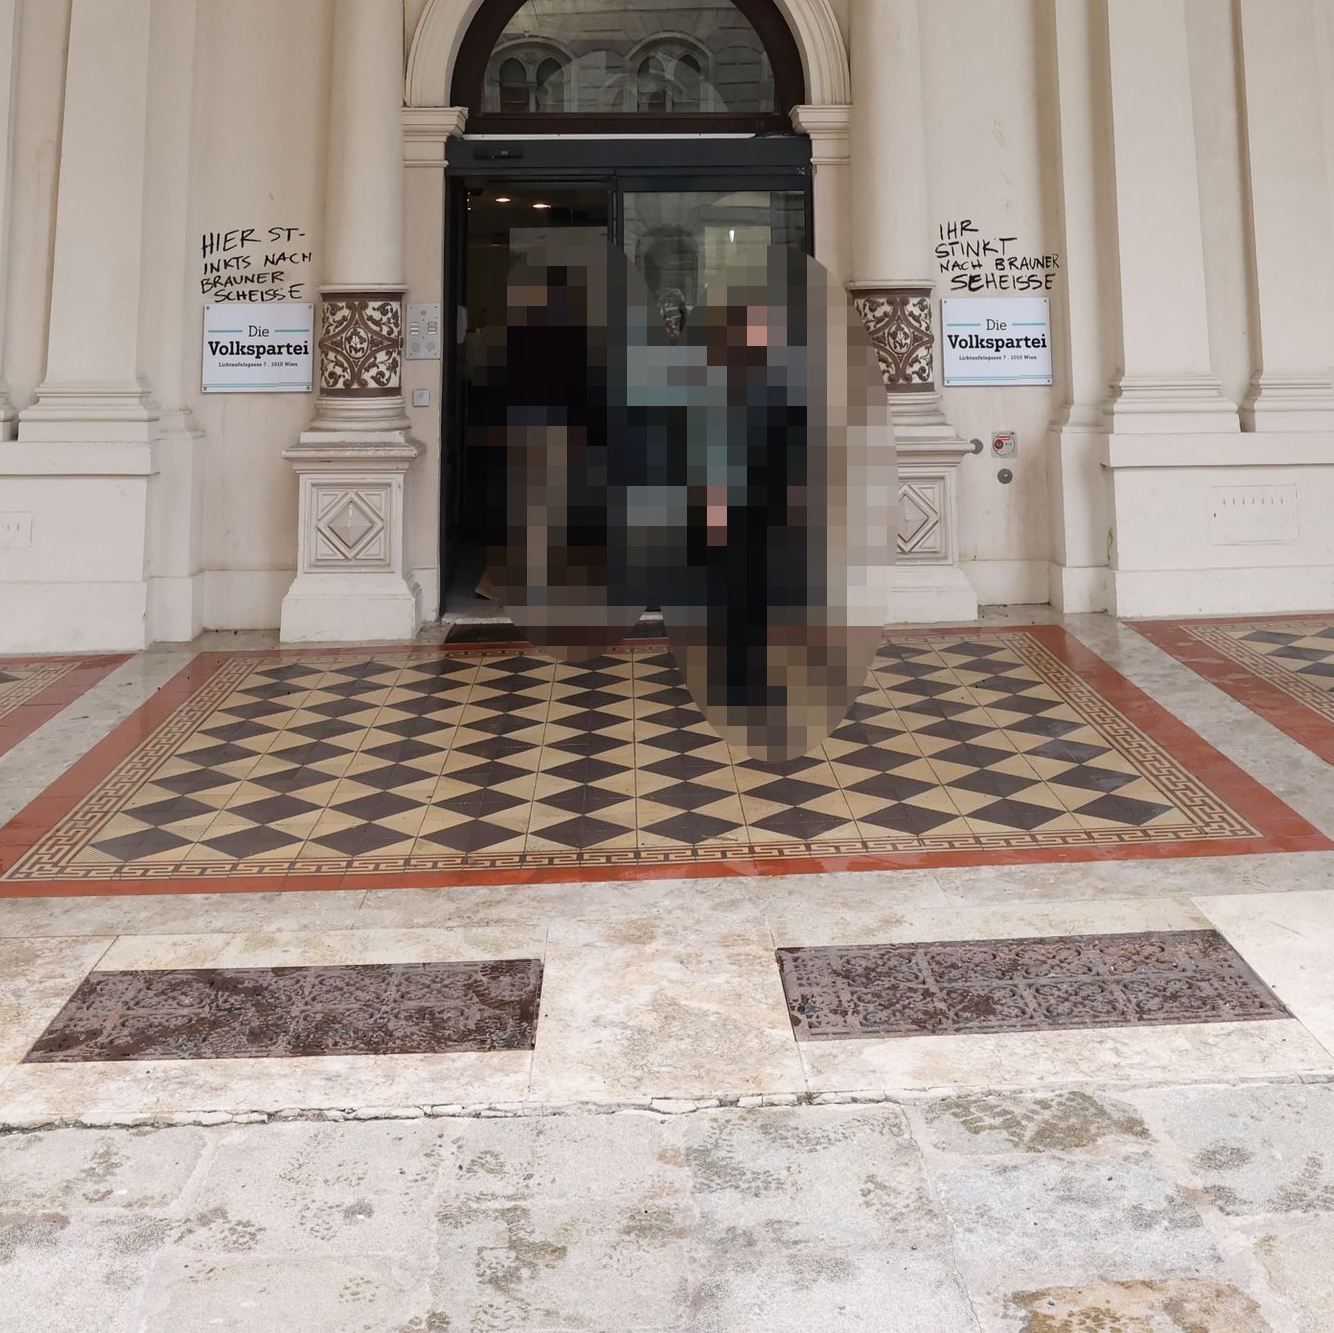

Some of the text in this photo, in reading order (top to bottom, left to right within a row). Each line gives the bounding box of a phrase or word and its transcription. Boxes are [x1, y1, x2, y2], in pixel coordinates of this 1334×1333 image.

[940, 219, 979, 240] IHR
[201, 229, 262, 258] HIER
[934, 237, 1018, 258] STINKT
[204, 252, 312, 275] INKTS NACH
[940, 253, 1059, 274] NACH BRAUNER
[201, 271, 284, 294] BRAUNER
[214, 283, 305, 303] SCHEISSE
[248, 324, 270, 337] Die
[986, 318, 1007, 331] Die
[208, 340, 309, 359] Volkspartei
[947, 333, 1047, 352] Volkspartei
